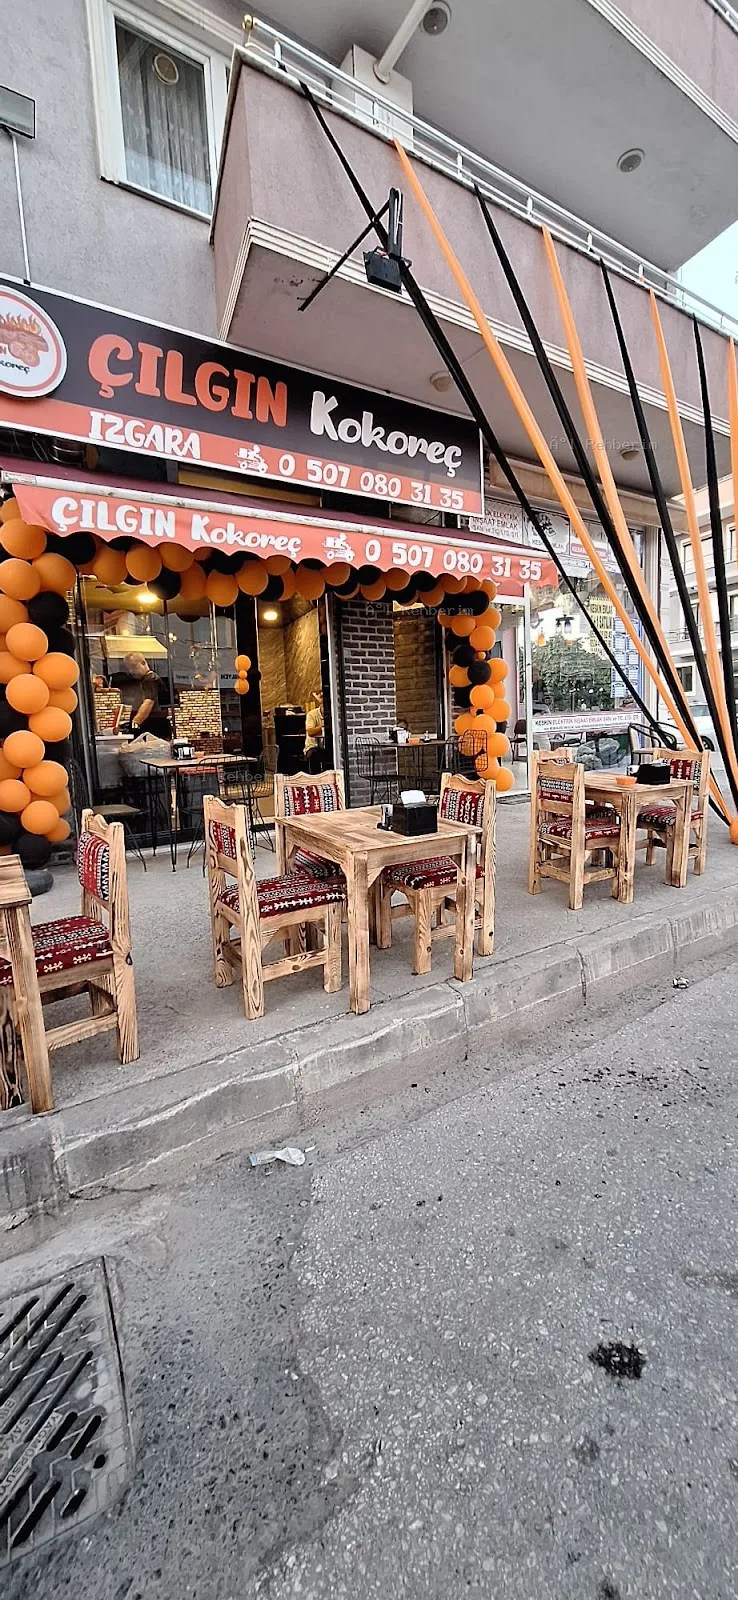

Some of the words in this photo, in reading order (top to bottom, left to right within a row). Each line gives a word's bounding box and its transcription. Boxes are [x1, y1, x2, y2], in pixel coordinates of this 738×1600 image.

[88, 334, 288, 427] ÇILGIN
[310, 391, 462, 478] Kokoreç
[88, 411, 201, 460] IZGARA
[278, 454, 296, 476] 0
[306, 459, 350, 487] 507
[359, 471, 402, 498] 080
[410, 481, 431, 503] 31
[439, 487, 464, 510] 35
[52, 496, 176, 539] ÇILGIN
[191, 513, 302, 560] Kokoreç
[365, 539, 382, 562] 0
[391, 542, 434, 568] 507
[443, 549, 483, 574] 080
[491, 555, 511, 577] 31
[518, 559, 542, 581] 35
